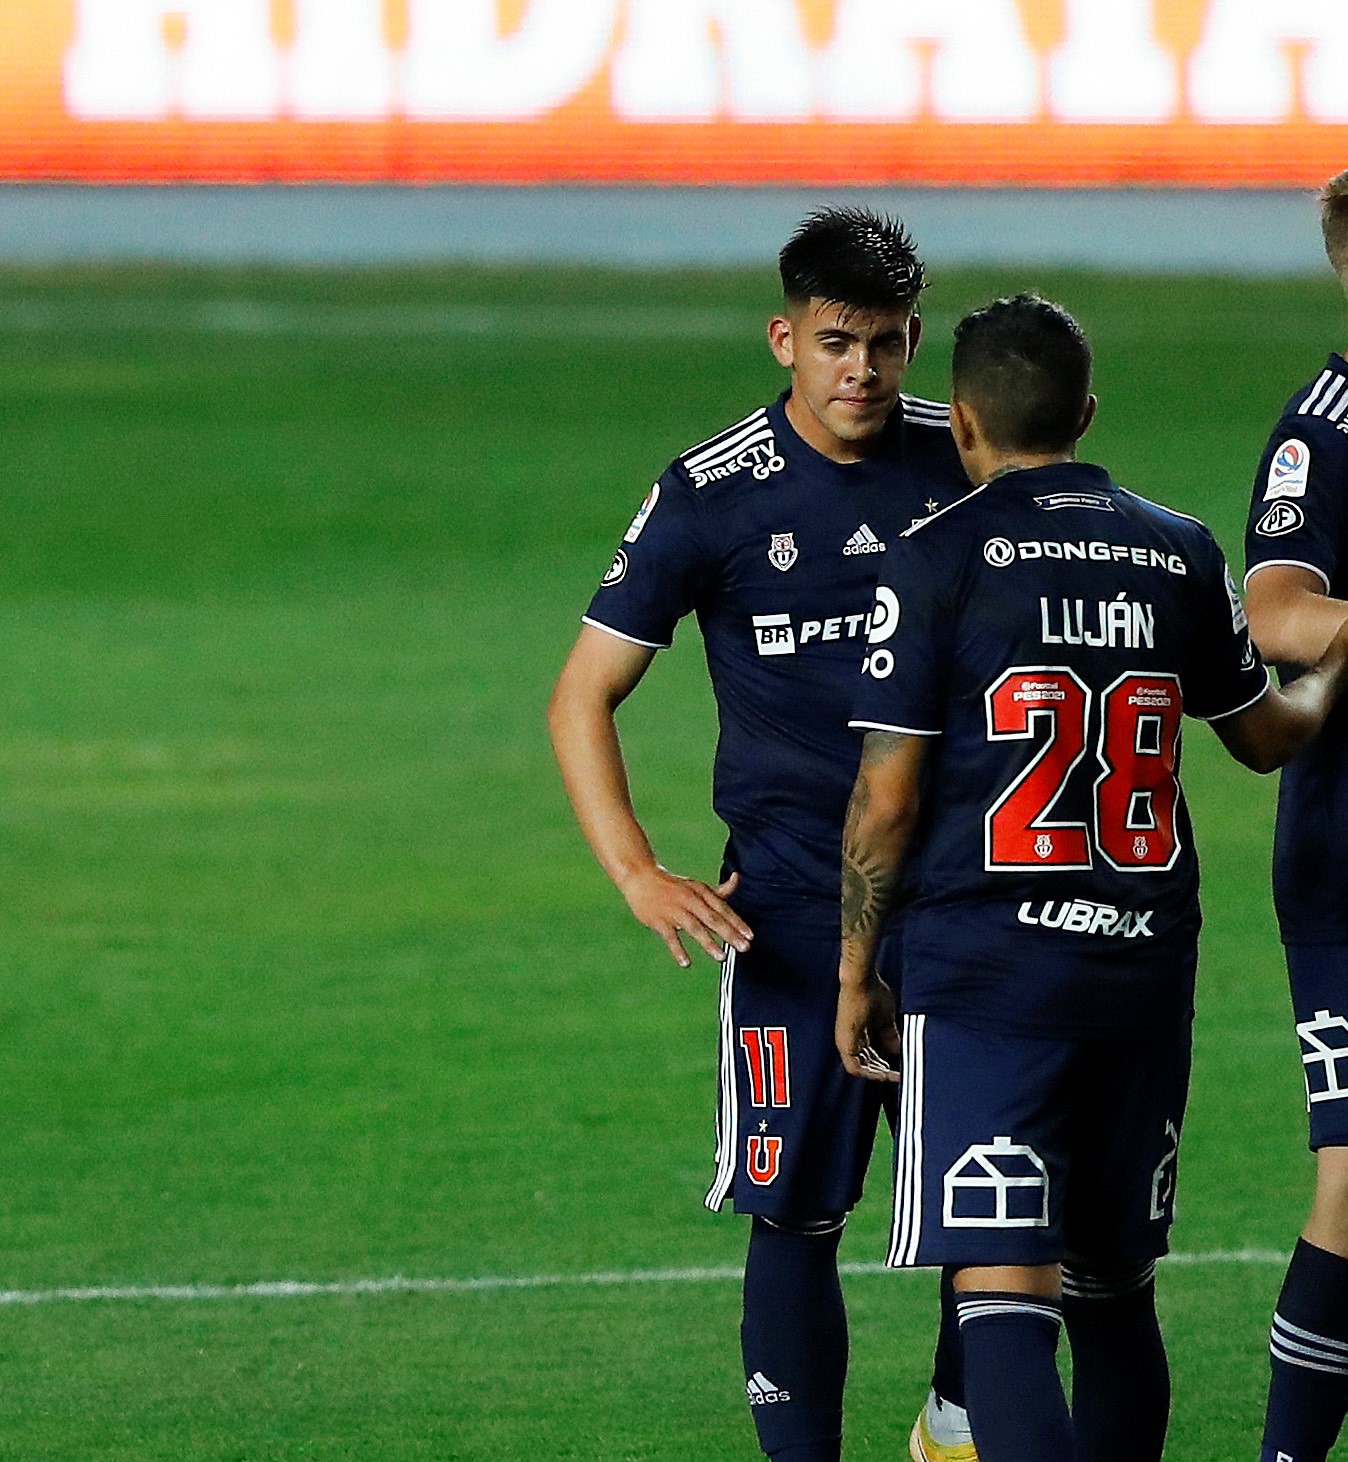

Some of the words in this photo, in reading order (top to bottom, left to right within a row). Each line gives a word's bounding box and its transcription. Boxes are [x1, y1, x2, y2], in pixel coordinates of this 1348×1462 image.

[689, 440, 776, 488] DIRECTV
[752, 455, 785, 480] GO
[843, 541, 886, 556] adidas
[1018, 541, 1187, 575] DONGFENG
[761, 628, 789, 644] BR
[1040, 592, 1154, 649] LUJÁN
[984, 666, 1184, 873] 28
[1017, 899, 1155, 938] LUBRAX
[739, 1027, 791, 1108] 11
[746, 1135, 783, 1186] U
